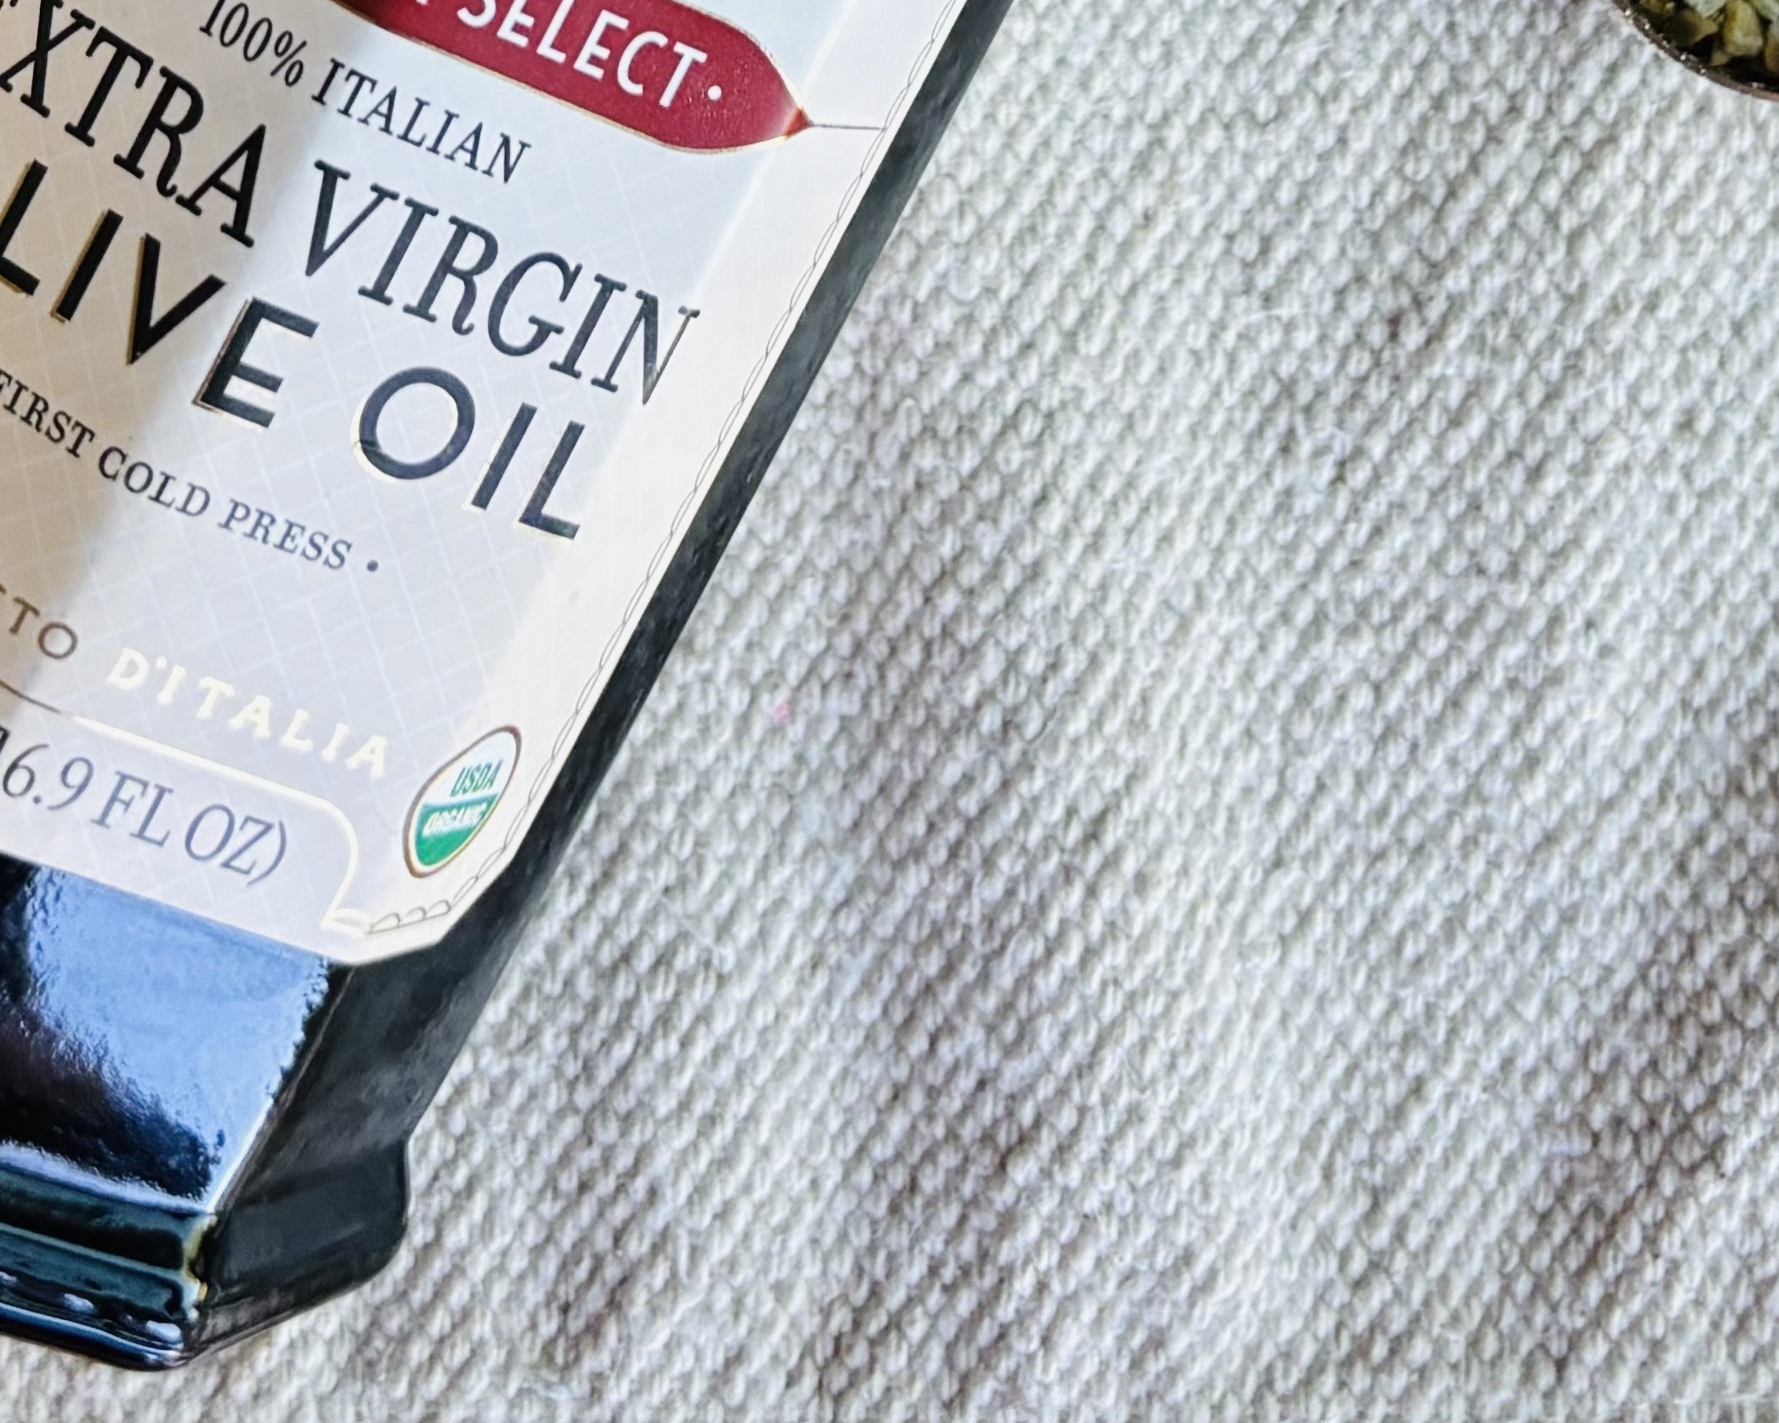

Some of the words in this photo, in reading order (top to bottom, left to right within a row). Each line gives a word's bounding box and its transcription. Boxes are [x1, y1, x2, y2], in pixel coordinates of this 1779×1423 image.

[311, 59, 532, 185] ITALIAN
[304, 159, 700, 406] VIRGIN
[97, 446, 212, 519] COLD
[219, 499, 354, 571] PRESS
[351, 366, 586, 539] OIL
[106, 647, 391, 779] D'ITALIA
[92, 768, 174, 850] FL
[181, 803, 288, 887] OZ)
[450, 757, 504, 798] USDA
